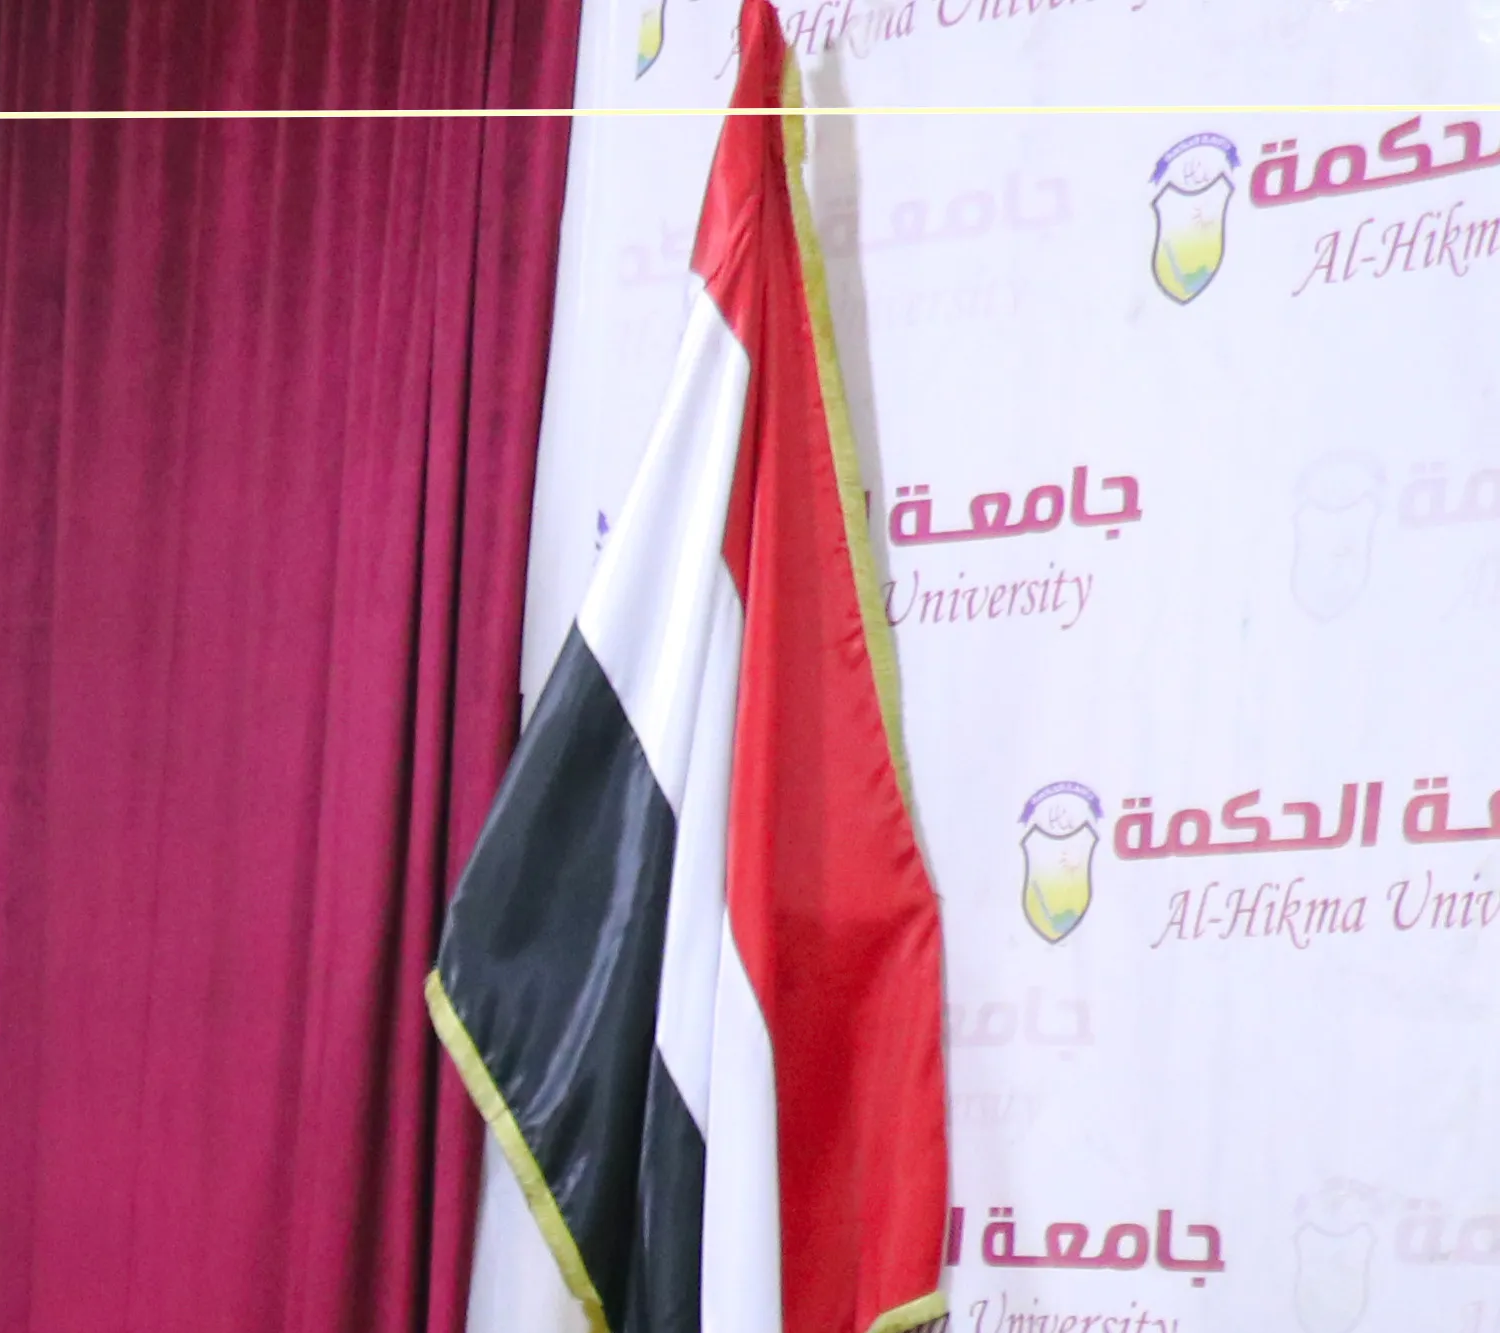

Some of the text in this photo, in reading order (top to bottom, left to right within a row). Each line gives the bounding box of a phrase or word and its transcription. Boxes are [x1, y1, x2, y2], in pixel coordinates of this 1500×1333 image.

[1290, 200, 1500, 297] Al-Hikm
[887, 465, 1143, 546] جامعة
[880, 563, 1094, 630] University
[1113, 782, 1383, 860] الحكمة
[1151, 880, 1368, 950] Al-Hikma
[980, 1205, 1226, 1289] جامعة
